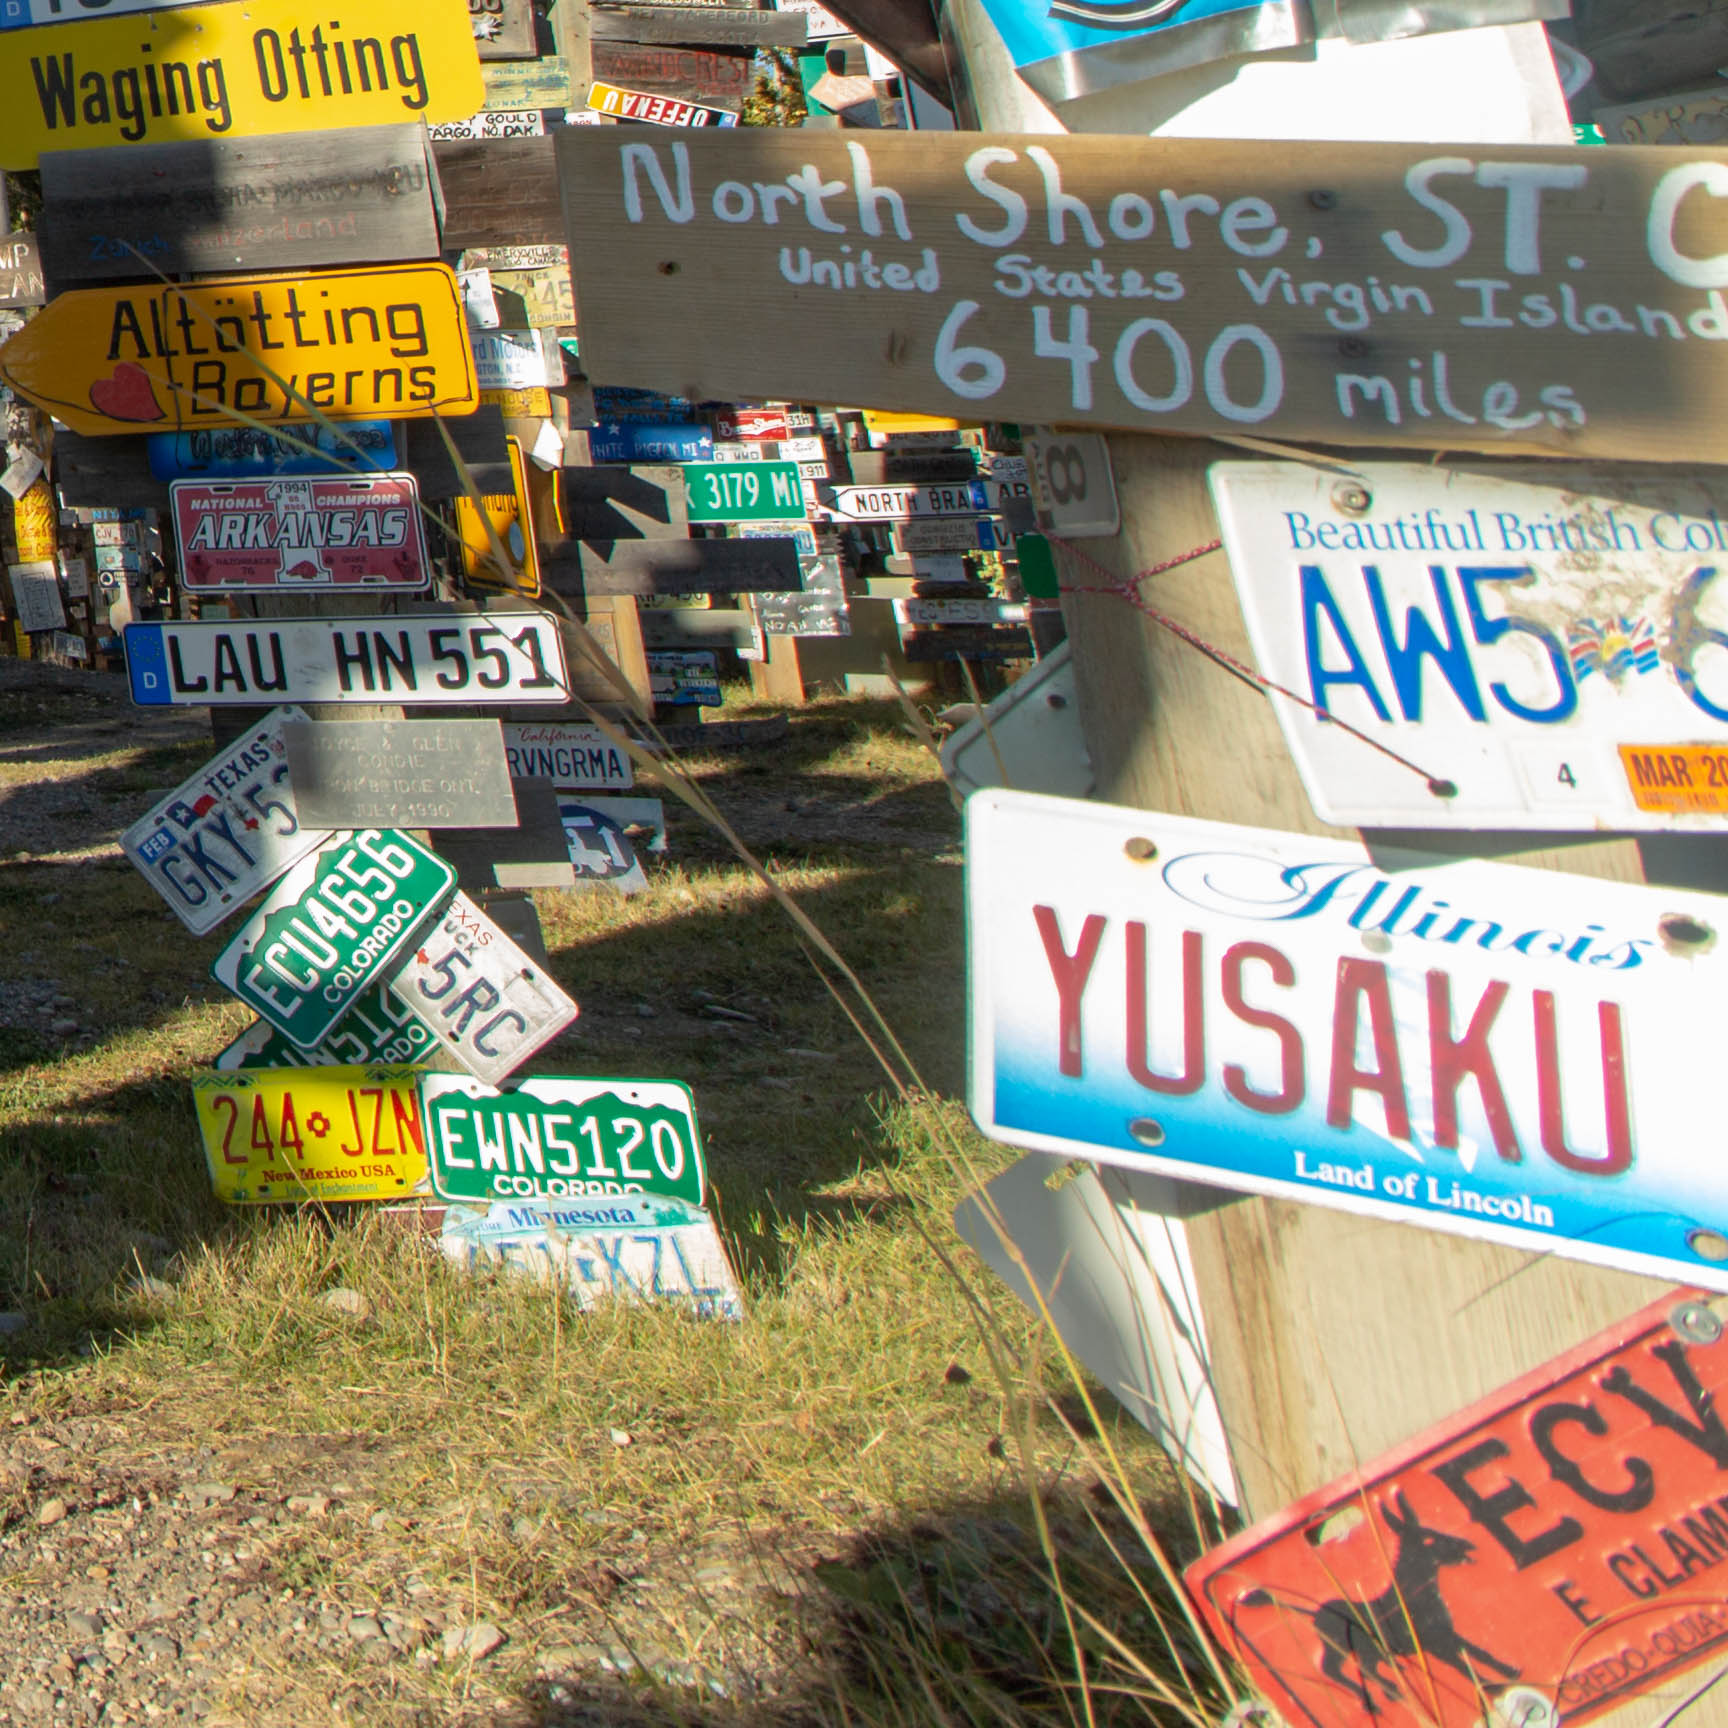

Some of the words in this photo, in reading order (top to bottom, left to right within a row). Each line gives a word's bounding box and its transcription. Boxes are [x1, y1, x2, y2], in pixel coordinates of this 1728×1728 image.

[30, 42, 233, 142] Waging
[253, 21, 430, 110] Otting
[619, 141, 912, 243] North
[956, 146, 1322, 259] Shore,
[1382, 156, 1587, 275] ST.
[104, 287, 430, 362] Altötting
[779, 247, 940, 294] United
[994, 253, 1185, 303] States
[1238, 267, 1433, 332] Virgin
[1336, 350, 1587, 430] miles
[190, 497, 264, 510] NATIONAL
[316, 493, 402, 507] CHAMPIONS
[705, 472, 759, 509] 3179
[773, 471, 801, 509] Mi
[188, 510, 409, 551] ARKANSAS
[1283, 510, 1484, 552] Beautiful
[1492, 510, 1641, 552] British
[167, 632, 288, 694] LAU
[333, 631, 417, 692] HN
[436, 626, 556, 690] 551
[517, 728, 599, 742] California
[243, 829, 417, 1021] ECU4656
[1160, 850, 1657, 972] Illinois
[322, 898, 414, 1005] COLORADO
[1033, 904, 1635, 1176] YUSAKU
[211, 1091, 304, 1164] 244
[341, 1086, 425, 1158] JZN
[441, 1108, 685, 1181] EWN5120
[262, 1170, 297, 1184] New
[300, 1166, 355, 1182] Mexico
[359, 1165, 396, 1180] USA
[1294, 1150, 1376, 1193] Land
[1383, 1173, 1419, 1199] of
[1426, 1175, 1555, 1229] Lincoln
[507, 1206, 636, 1228] Minnesota
